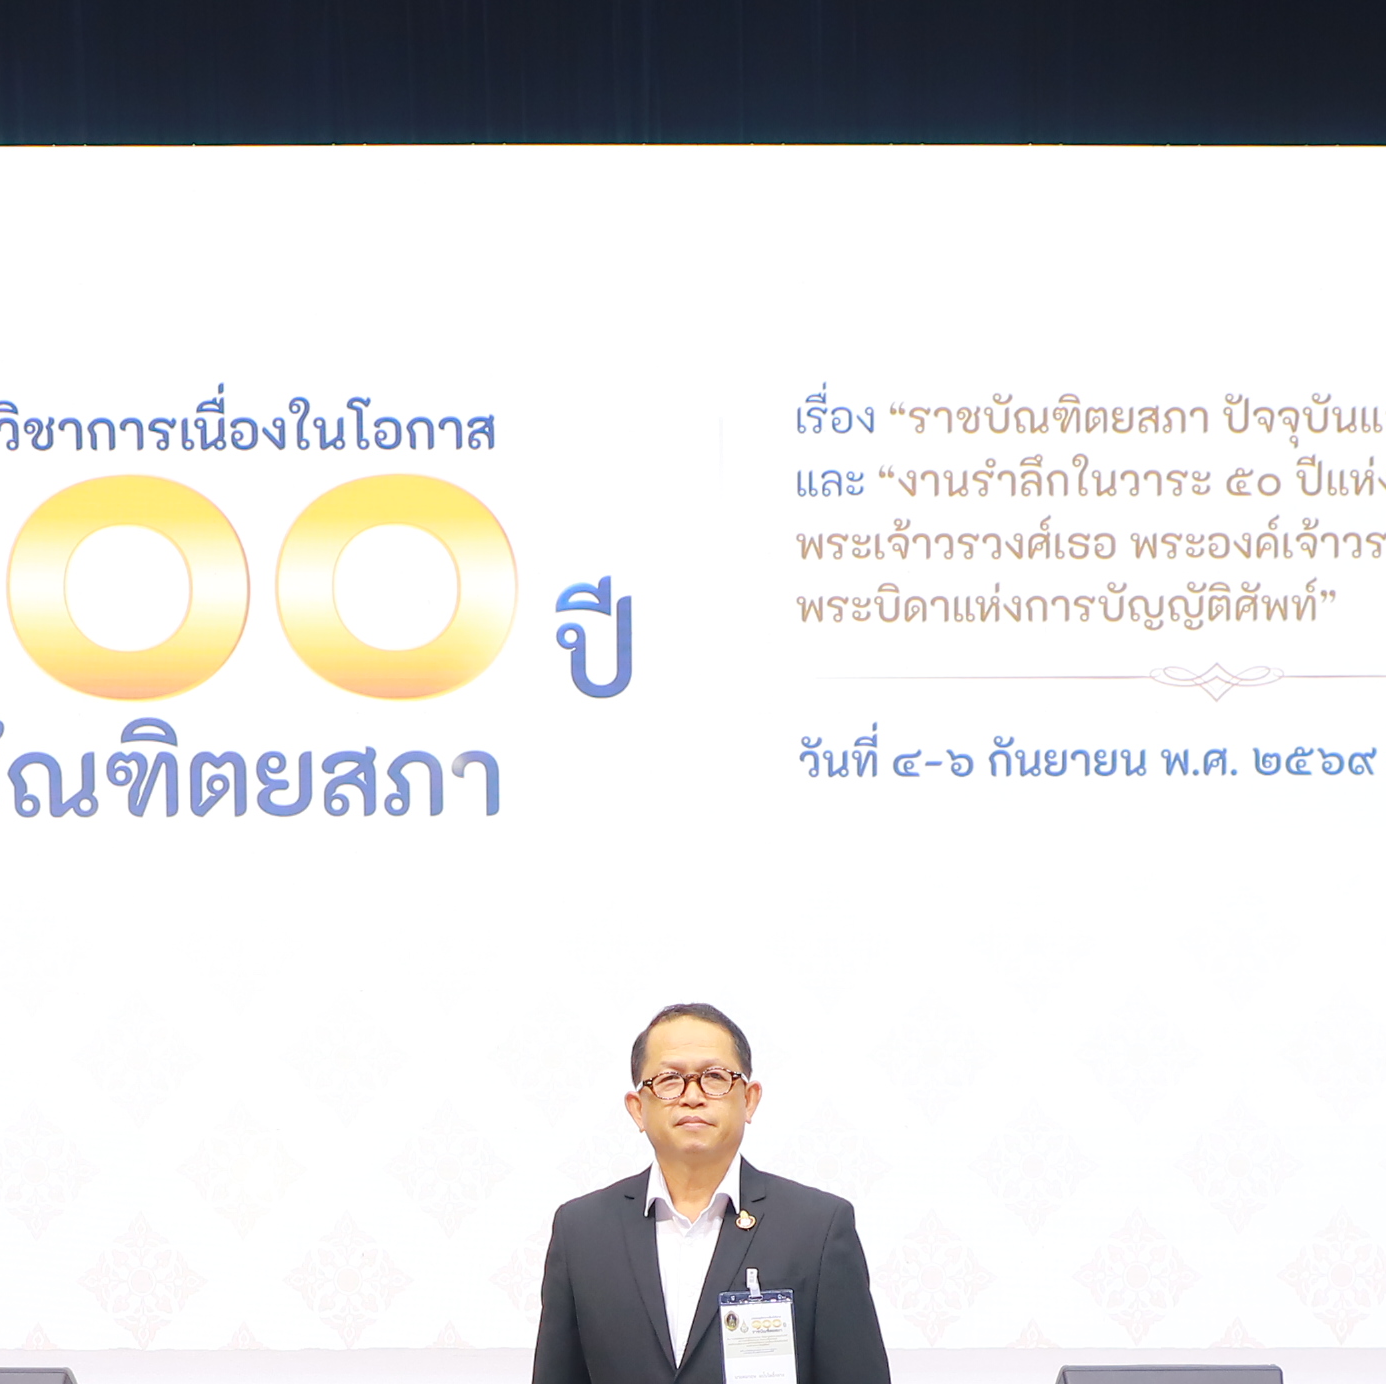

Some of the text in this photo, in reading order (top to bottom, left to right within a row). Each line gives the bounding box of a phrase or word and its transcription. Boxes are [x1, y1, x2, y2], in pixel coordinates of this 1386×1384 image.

[796, 381, 876, 435] เรื่อง
[889, 392, 1209, 435] “ราชบัณฑิตยสภา
[796, 468, 865, 498] และ
[878, 452, 1212, 498] “งานรำลึกในวาระ
[1225, 466, 1282, 498] ๕๐
[795, 514, 1117, 561] พระเจ้าวรวงศ์เธอ
[795, 576, 1337, 632] พระบิดาแห่งการบัญญัติศัพท์”
[555, 575, 633, 700] ปี
[798, 721, 879, 779] วันที่
[892, 748, 975, 778] ๔-๖
[987, 734, 1148, 778] กันยายน
[1160, 746, 1239, 777] พ.ศ.
[1251, 745, 1379, 777] ๒๕๖๙
